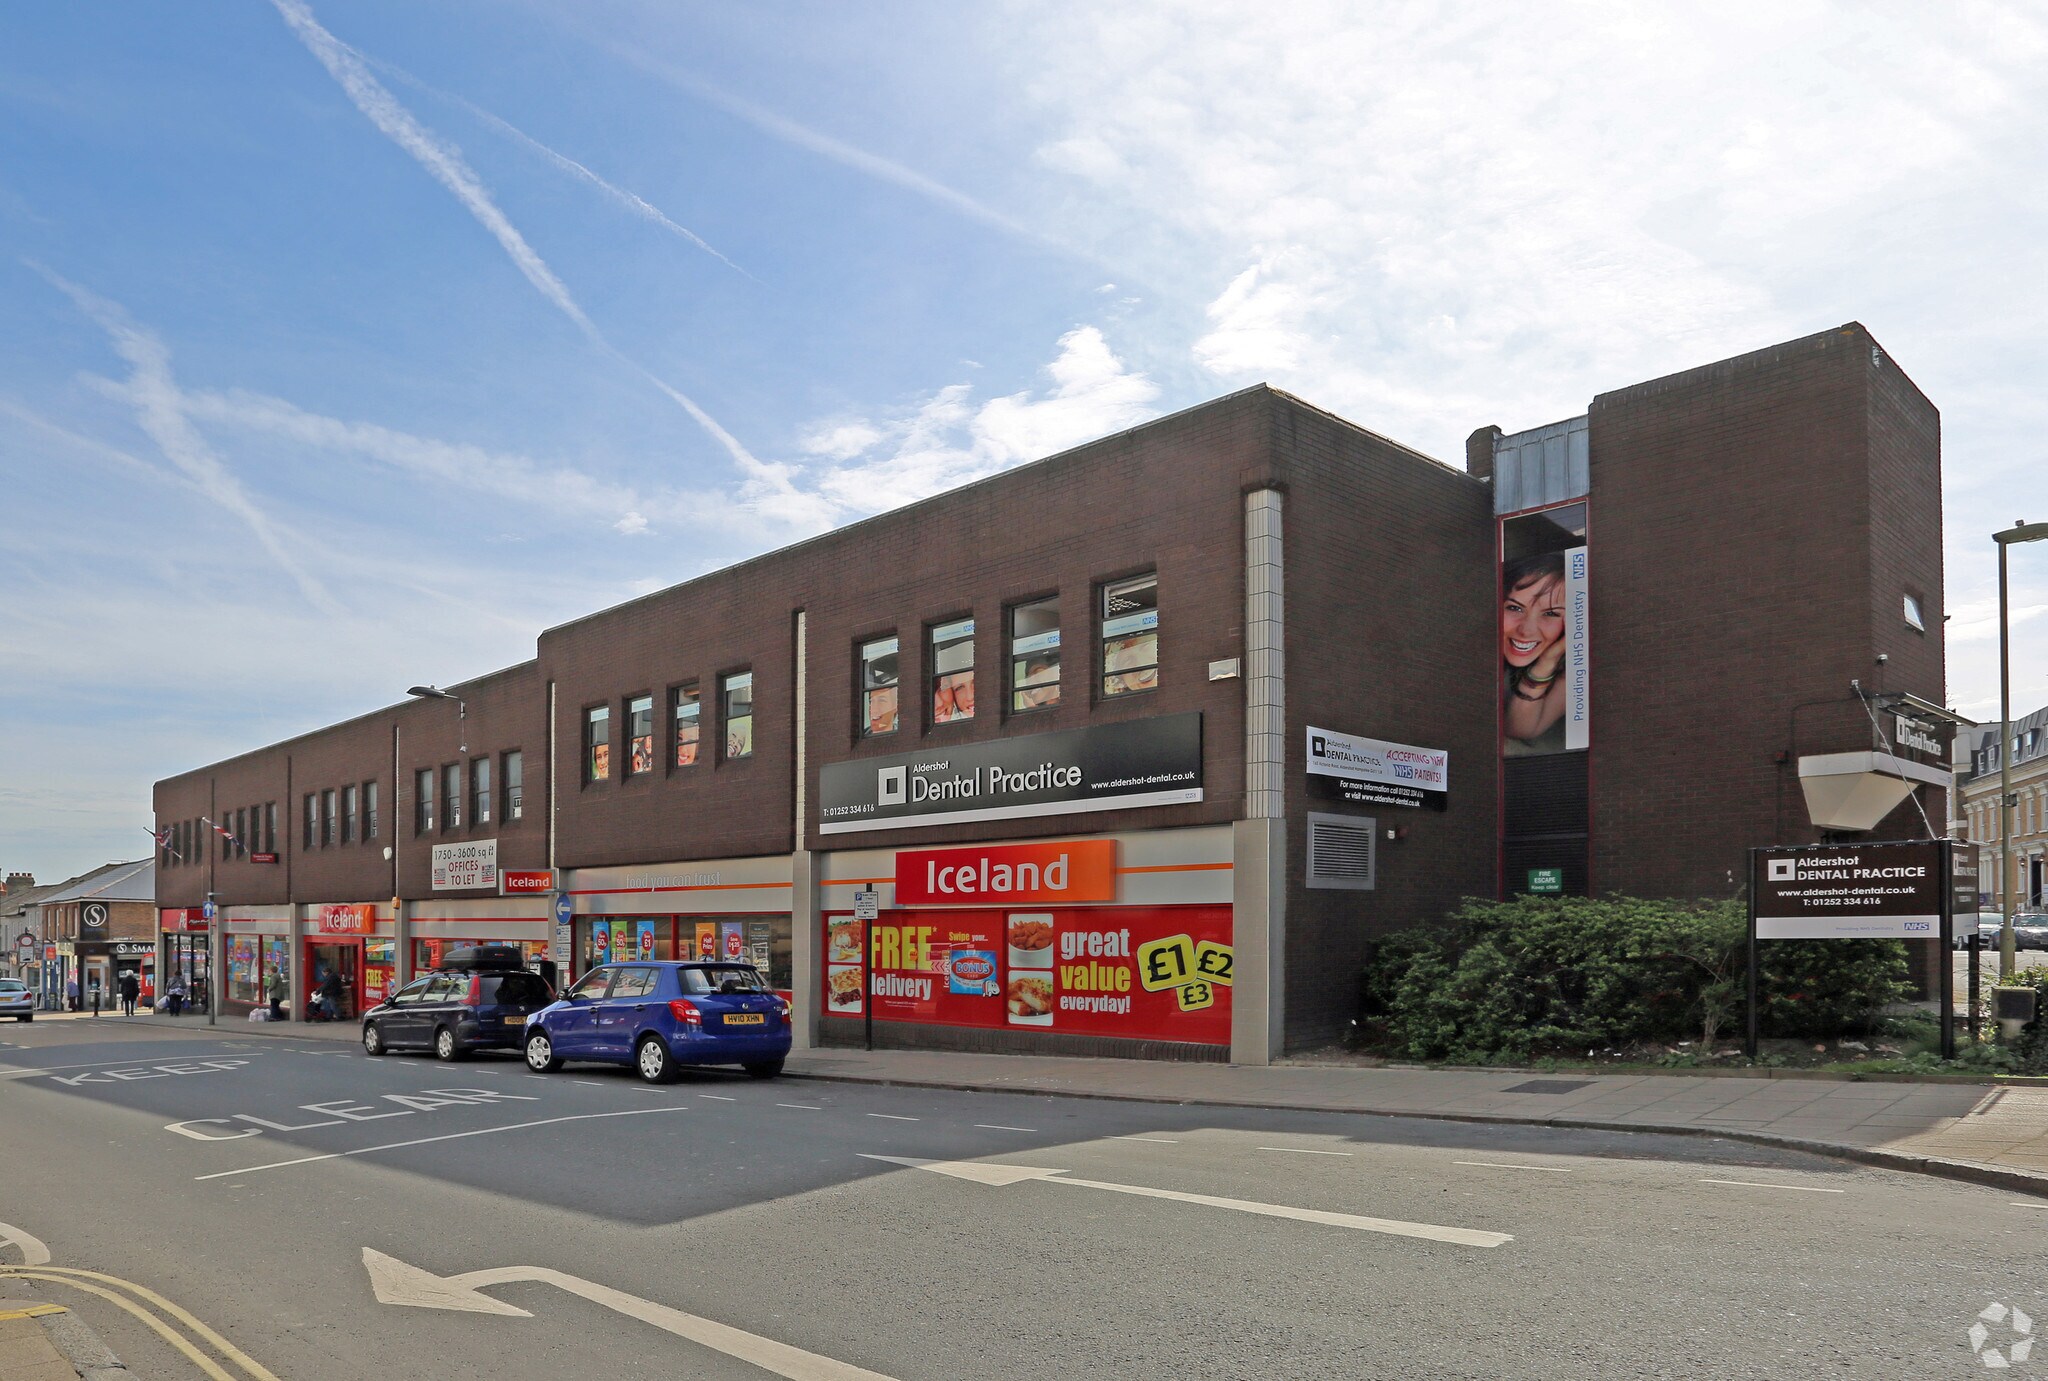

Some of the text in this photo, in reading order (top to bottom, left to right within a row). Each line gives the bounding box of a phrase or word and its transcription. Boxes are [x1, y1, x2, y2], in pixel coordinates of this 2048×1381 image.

[1573, 553, 1585, 579] NHS
[1573, 590, 1586, 721] Providing NHS Dentistry
[912, 760, 950, 773] Aldershot
[1326, 750, 1382, 766] DENTAL PRACTICE
[1386, 750, 1445, 767] ACCEPTING NEW
[912, 763, 1083, 802] Dental Practice
[1091, 771, 1195, 789] www.aldershot-dental.co.uk
[1395, 765, 1442, 783] NHS PATIENTS!
[1340, 780, 1348, 788] For
[1349, 781, 1363, 790] more
[1363, 782, 1389, 793] information
[1390, 787, 1398, 795] call
[823, 803, 875, 816] T: 01252 334 616
[434, 849, 452, 860] 1750
[457, 847, 476, 858] 3600
[478, 849, 487, 859] sq
[1797, 855, 1859, 867] Aldershot
[448, 860, 479, 872] OFFICES
[927, 853, 1069, 894] Iceland
[1797, 866, 1925, 881] DENTAL PRACTICE
[451, 875, 461, 885] TO
[463, 874, 475, 885] LET
[508, 877, 549, 887] Iceland
[626, 871, 721, 892] food you can trust
[1534, 876, 1556, 884] ESCAPE
[1777, 886, 1916, 897] www.aldershot-dental.co.uk
[1813, 898, 1841, 906] 01252
[1863, 897, 1881, 905] 616
[326, 910, 361, 928] Iceland
[1905, 922, 1929, 931] NHS
[949, 931, 970, 942] Swipe
[1060, 928, 1131, 961] great
[956, 962, 989, 974] BONUS
[1147, 943, 1186, 983] £1
[1198, 949, 1233, 979] £2
[366, 968, 383, 988] FREE
[1060, 961, 1131, 992] value
[1183, 984, 1210, 1006] £3
[1060, 995, 1131, 1014] everyday!
[728, 1015, 744, 1023] HV10
[49, 1059, 251, 1086] KEEP
[164, 1088, 540, 1141] CLEAR
